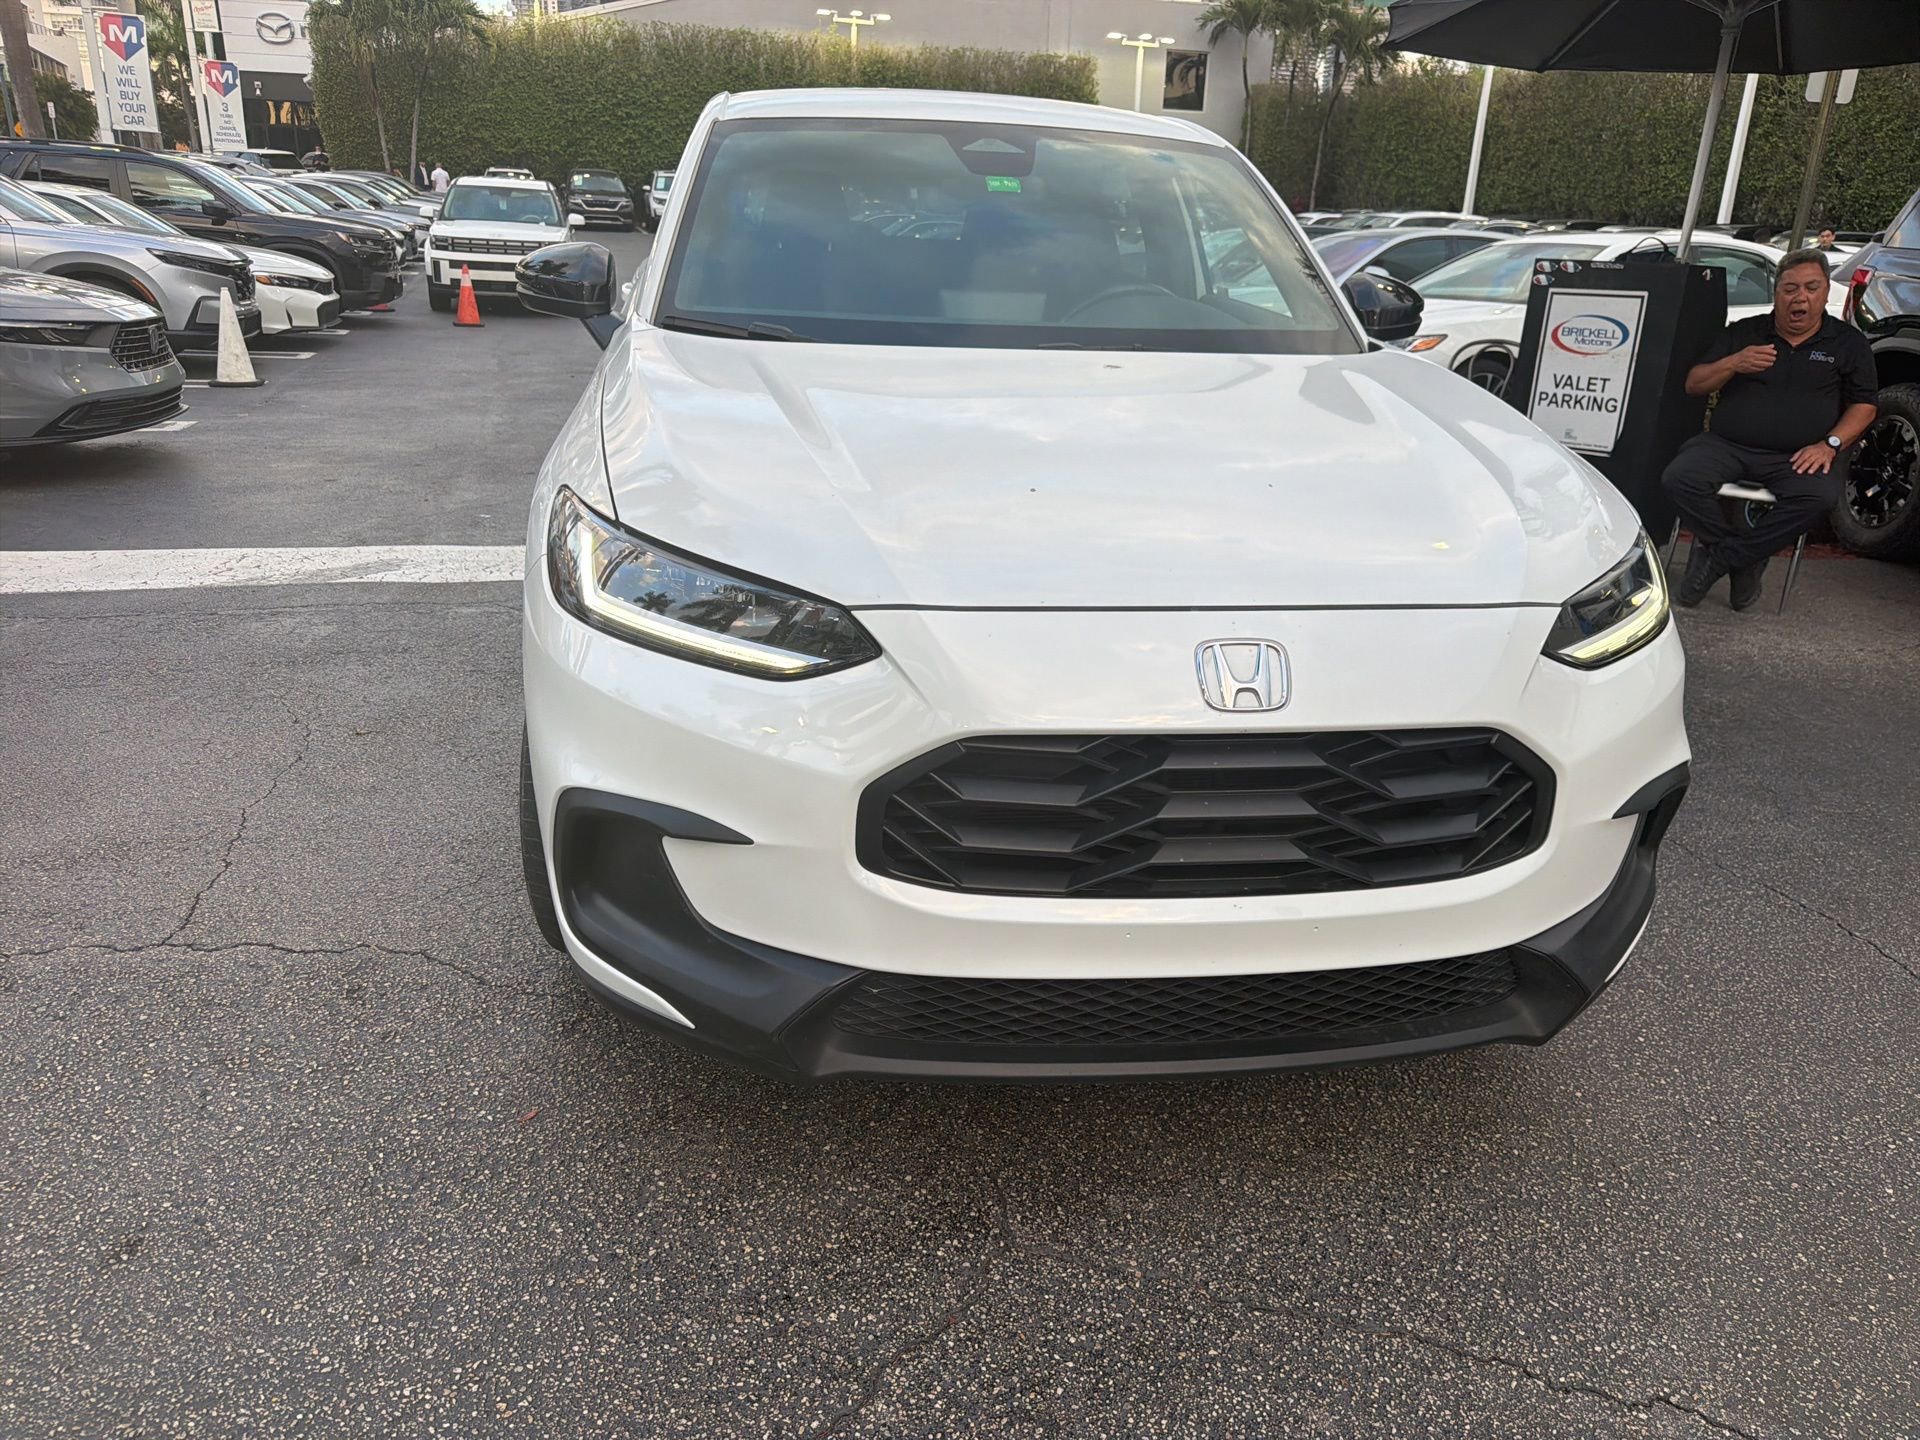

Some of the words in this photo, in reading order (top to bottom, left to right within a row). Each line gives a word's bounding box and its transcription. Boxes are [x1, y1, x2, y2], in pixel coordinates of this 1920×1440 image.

[117, 64, 136, 76] WE
[115, 76, 142, 89] WILL
[119, 90, 141, 101] BUY
[117, 102, 147, 113] YOUR
[221, 102, 229, 113] 3
[123, 115, 145, 126] CAR
[1561, 326, 1620, 340] BRICKELL
[1573, 337, 1613, 347] Motors
[1553, 372, 1612, 394] VALET
[1537, 391, 1619, 414] PARKING
